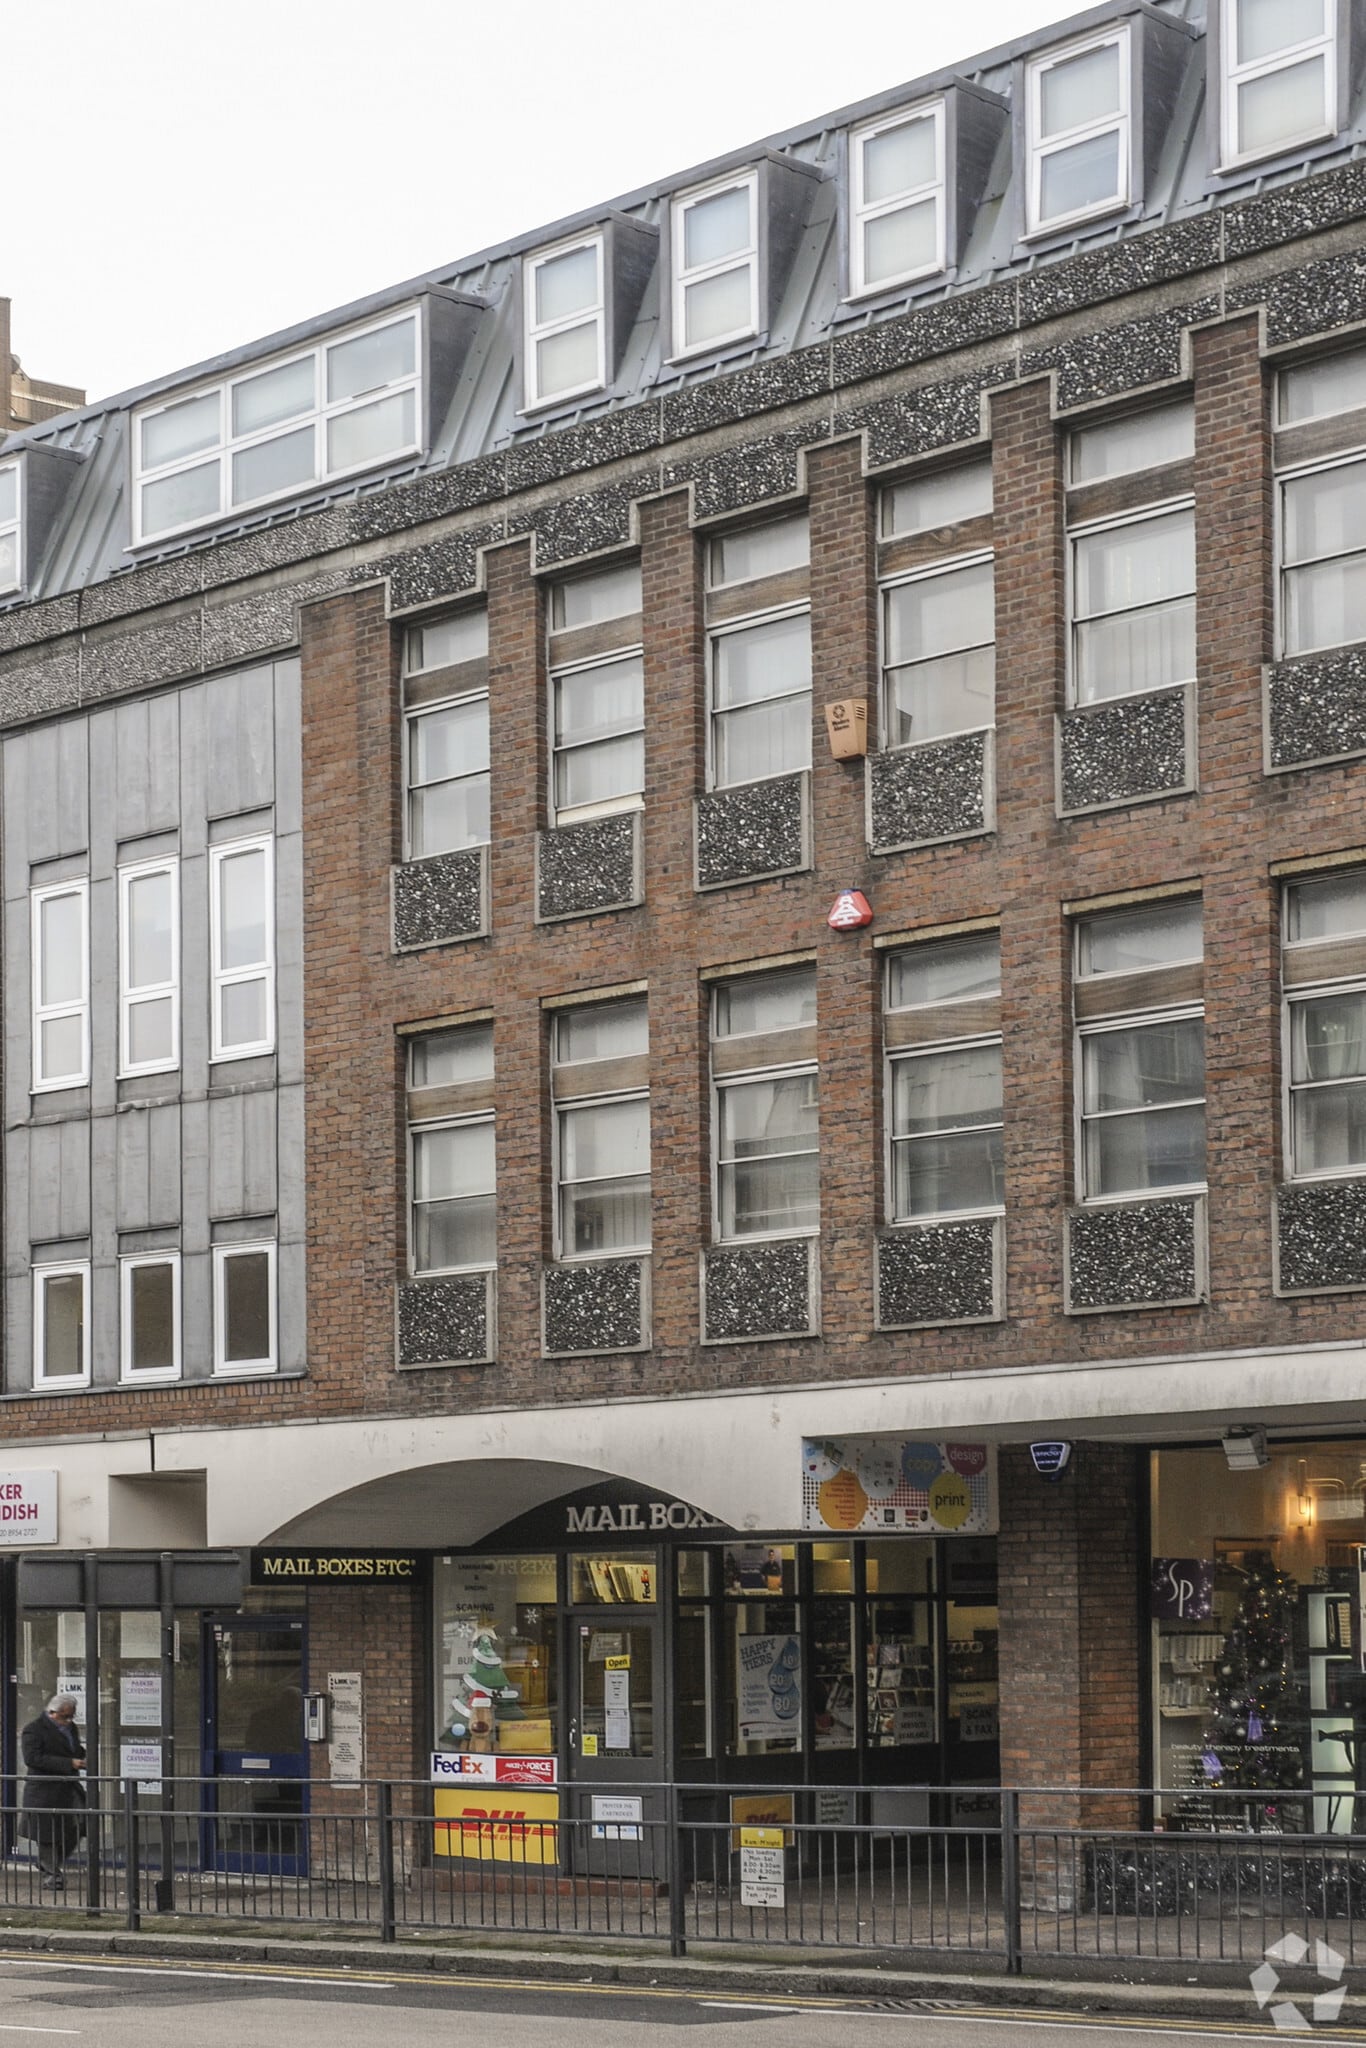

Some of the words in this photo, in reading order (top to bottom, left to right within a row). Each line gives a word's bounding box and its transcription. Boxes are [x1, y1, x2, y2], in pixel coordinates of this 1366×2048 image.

[950, 1448, 984, 1465] design
[935, 1493, 965, 1511] print
[566, 1504, 647, 1533] MAIL
[650, 1502, 727, 1529] BOX
[263, 1558, 314, 1575] MAIL
[317, 1558, 373, 1576] BOXES
[740, 1638, 776, 1660] HAPPY
[608, 1658, 628, 1667] Open
[65, 1684, 82, 1693] LMK
[965, 1709, 993, 1720] SCAN
[974, 1725, 993, 1735] FAX
[1205, 1744, 1241, 1753] therapy
[1244, 1745, 1300, 1753] treatments
[433, 1754, 483, 1774] FedEx
[955, 1796, 994, 1814] FedEx
[461, 1808, 530, 1836] DHL
